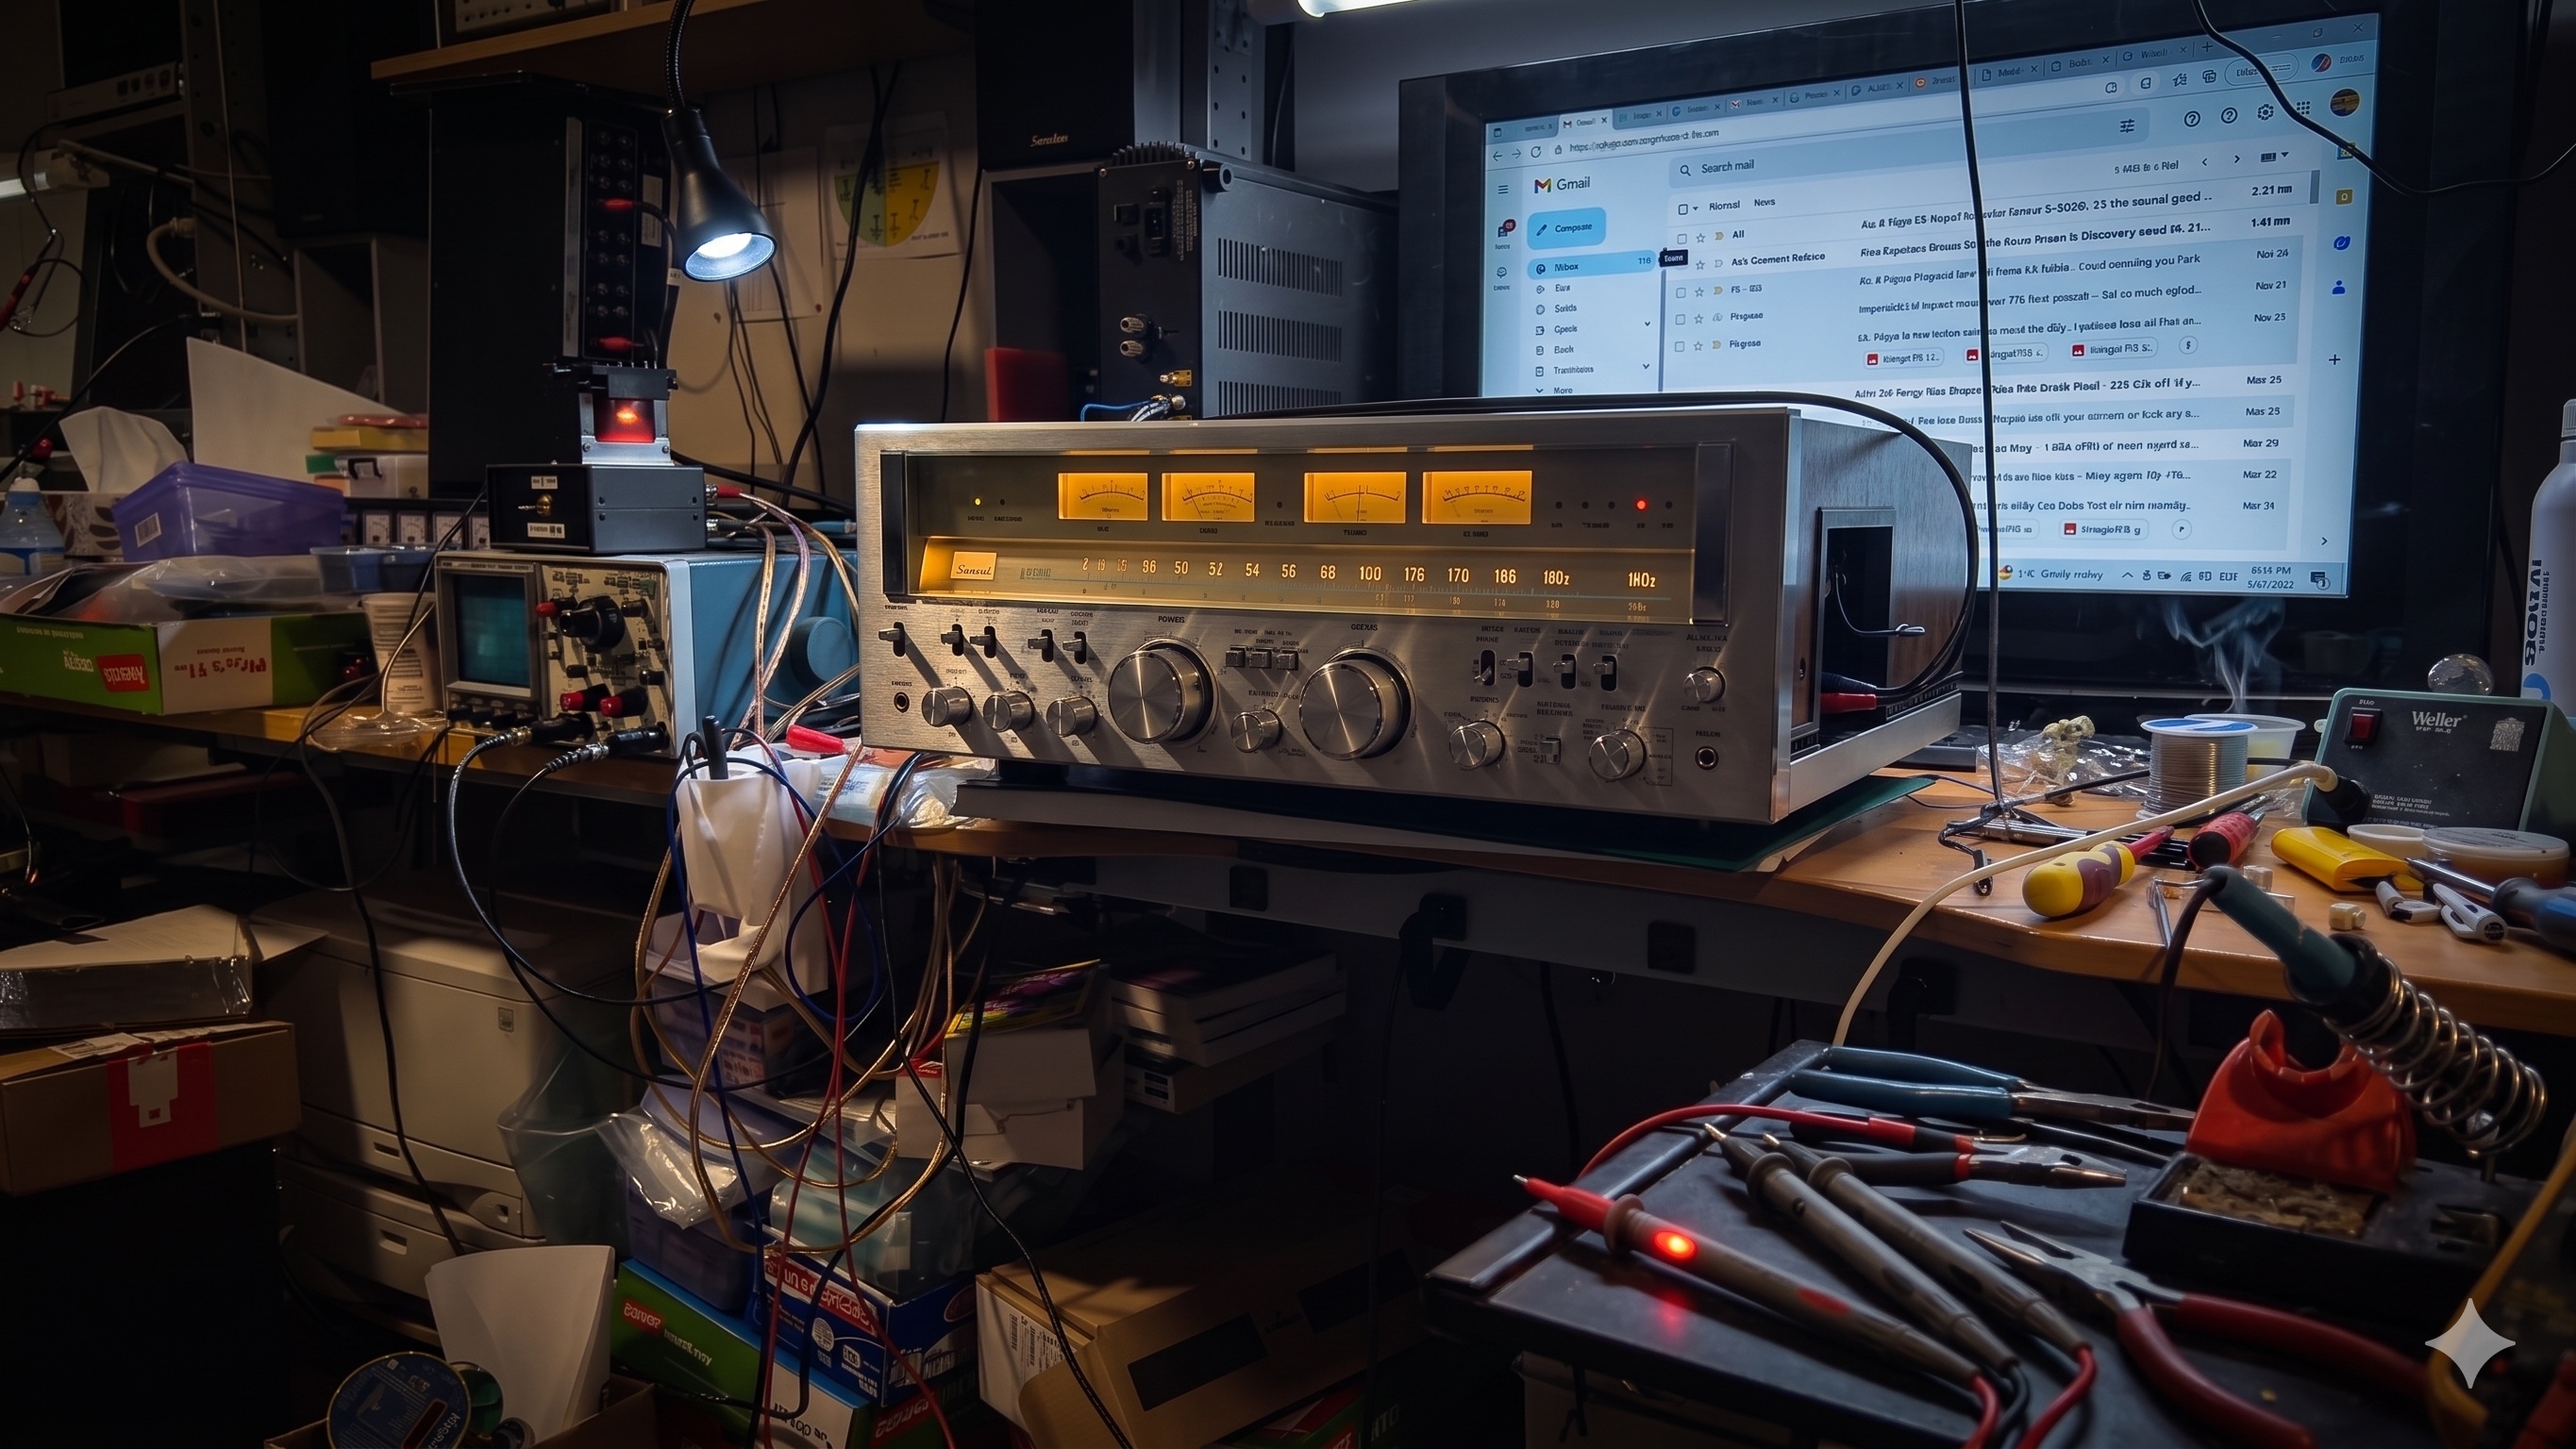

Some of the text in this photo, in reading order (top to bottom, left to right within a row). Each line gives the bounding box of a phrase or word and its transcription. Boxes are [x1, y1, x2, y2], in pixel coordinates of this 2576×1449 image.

[1701, 159, 1755, 175] Search mail
[1556, 176, 1591, 192] Gmail
[2251, 185, 2274, 196] 2.21
[2110, 197, 2129, 208] the
[2251, 216, 2272, 227] 1.41
[1732, 230, 1745, 239] All
[1986, 236, 2001, 247] the
[2081, 227, 2136, 242] Discovery
[2154, 256, 2175, 268] you
[2177, 254, 2200, 265] Park
[2275, 280, 2286, 290] 21
[2134, 287, 2163, 297] much
[2028, 325, 2044, 333] the
[2110, 380, 2130, 389] 225
[2127, 410, 2139, 420] or
[2266, 439, 2279, 447] 29
[2265, 470, 2277, 479] 22
[2058, 501, 2084, 510] Dobs
[2087, 501, 2107, 509] Yost
[2125, 501, 2145, 509] nim
[1174, 561, 1189, 575] 50
[1245, 563, 1260, 577] 54
[1281, 563, 1296, 578] 56
[1320, 565, 1336, 579] 68
[1359, 566, 1381, 581] 100
[1404, 567, 1425, 581] 176
[1447, 568, 1469, 583] 170
[2276, 566, 2291, 575] PM
[2247, 580, 2294, 590] 5/67/2022
[2412, 710, 2462, 727] Weller
